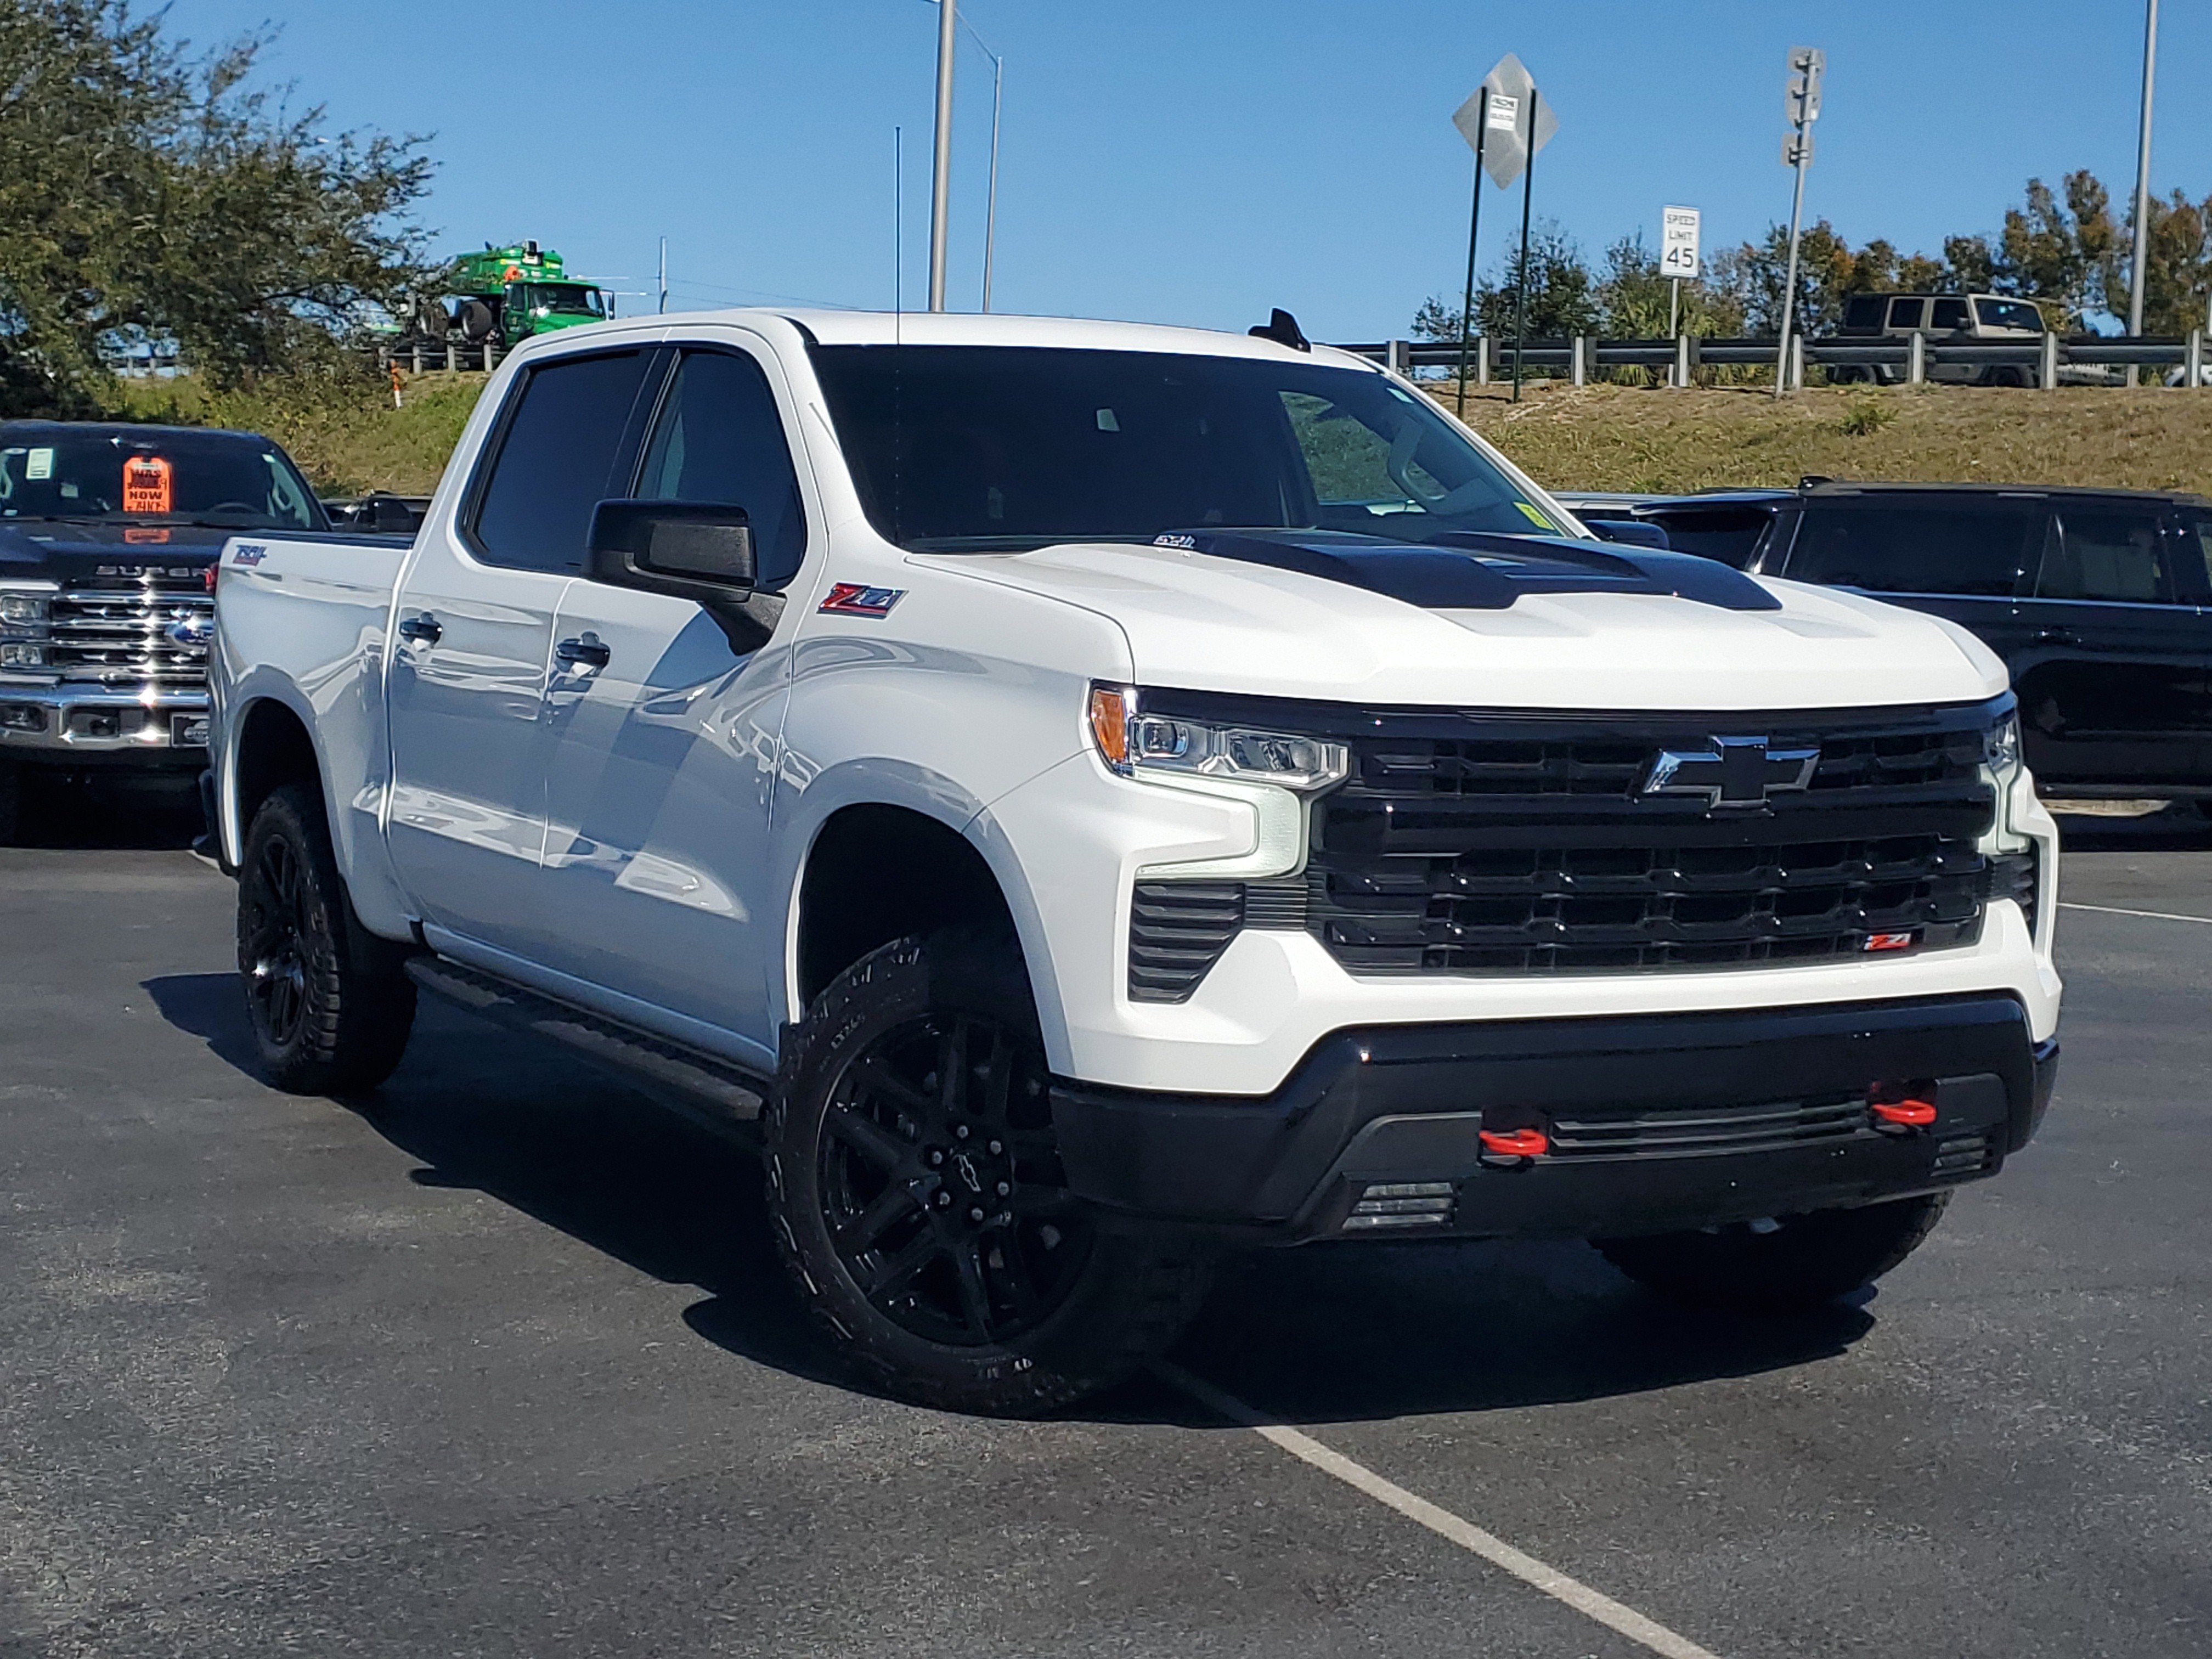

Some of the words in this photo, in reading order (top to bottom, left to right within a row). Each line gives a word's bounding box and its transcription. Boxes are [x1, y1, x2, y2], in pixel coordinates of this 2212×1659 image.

[1667, 214, 1696, 226] SPEED
[1669, 230, 1694, 240] LIMIT
[1667, 246, 1694, 268] 45
[129, 491, 162, 500] NOW
[95, 565, 211, 578] SUPER
[817, 582, 909, 619] Z71
